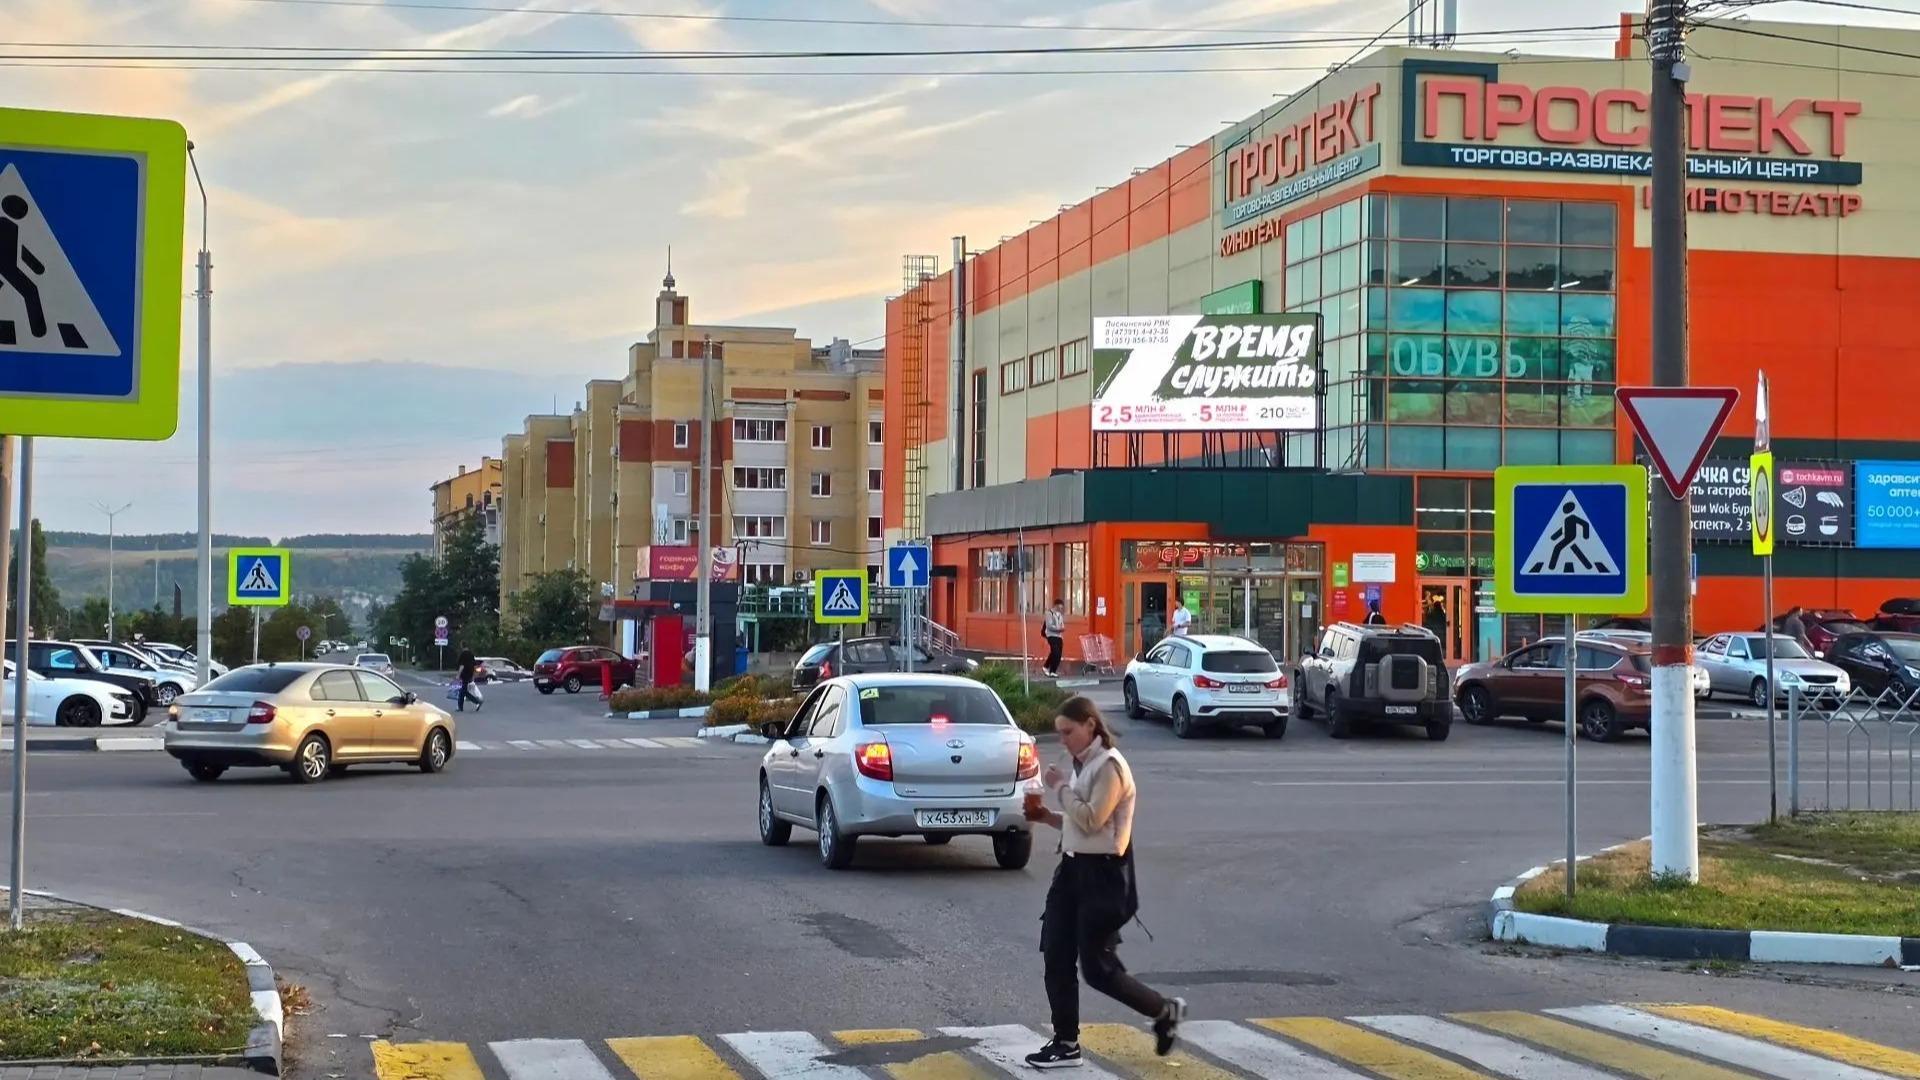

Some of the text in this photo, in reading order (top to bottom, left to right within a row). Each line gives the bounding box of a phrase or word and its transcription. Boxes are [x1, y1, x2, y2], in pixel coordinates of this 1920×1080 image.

[1226, 82, 1381, 202] ПРОСПЕКТ
[1332, 156, 1361, 181] ЦЕНТР
[1451, 146, 1819, 178] ТОРГОВО-РАЗВЛЕКАЛЬНЫЙ ЦЕНТР
[1190, 323, 1315, 360] ВРЕМЯ
[1393, 337, 1527, 378] ОБУВЬ
[1100, 405, 1133, 427] 2,5
[1135, 405, 1158, 413] МЛН
[1199, 404, 1213, 423] 5
[1260, 407, 1284, 419] 210
[1709, 502, 1730, 514] Wok
[1732, 503, 1751, 517] Бур
[1868, 506, 1884, 517] 50
[1736, 518, 1743, 531] 2
[659, 555, 697, 563] горячий
